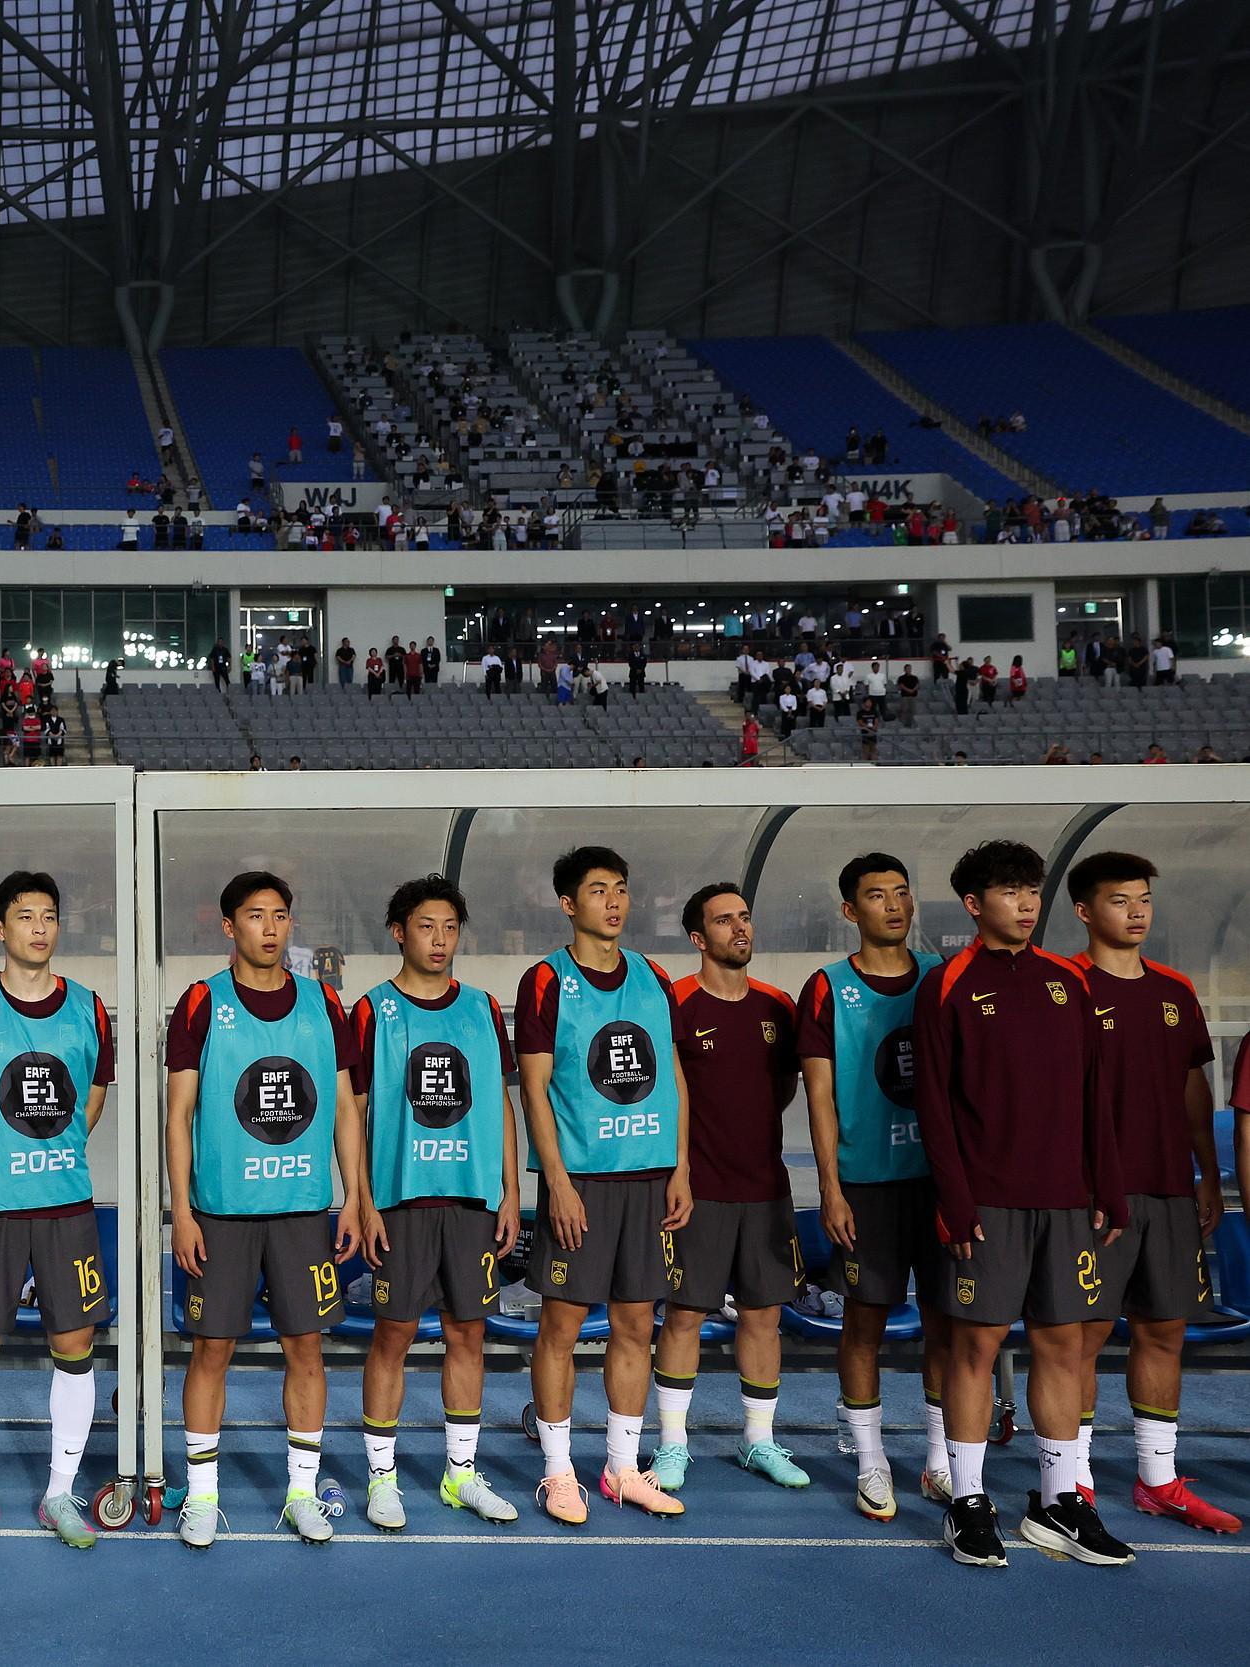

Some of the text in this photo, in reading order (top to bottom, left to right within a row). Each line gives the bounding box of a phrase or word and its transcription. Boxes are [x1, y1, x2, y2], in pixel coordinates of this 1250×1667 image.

[304, 487, 355, 507] W4J
[941, 935, 972, 947] EAFF
[981, 1004, 996, 1015] 52
[1102, 1019, 1114, 1030] 50
[611, 1035, 633, 1046] EAFF
[702, 1039, 714, 1050] 54
[899, 1040, 912, 1052] EA
[425, 1057, 450, 1068] EAFF
[609, 1048, 641, 1071] E-1
[25, 1067, 50, 1078] EAFF
[262, 1071, 289, 1084] EAFF
[421, 1071, 455, 1093] E-1
[603, 1075, 649, 1085] CHAMPIONSHIP
[22, 1081, 58, 1104] E-1
[259, 1085, 295, 1109] E-1
[251, 1115, 303, 1123] CHAMPIONSHIP
[599, 1113, 660, 1139] 2025
[891, 1122, 921, 1146] 20
[11, 1148, 75, 1175] 2025
[245, 1154, 311, 1180] 2025
[73, 1255, 101, 1298] 16
[481, 1251, 495, 1289] 7
[309, 1261, 338, 1303] 19
